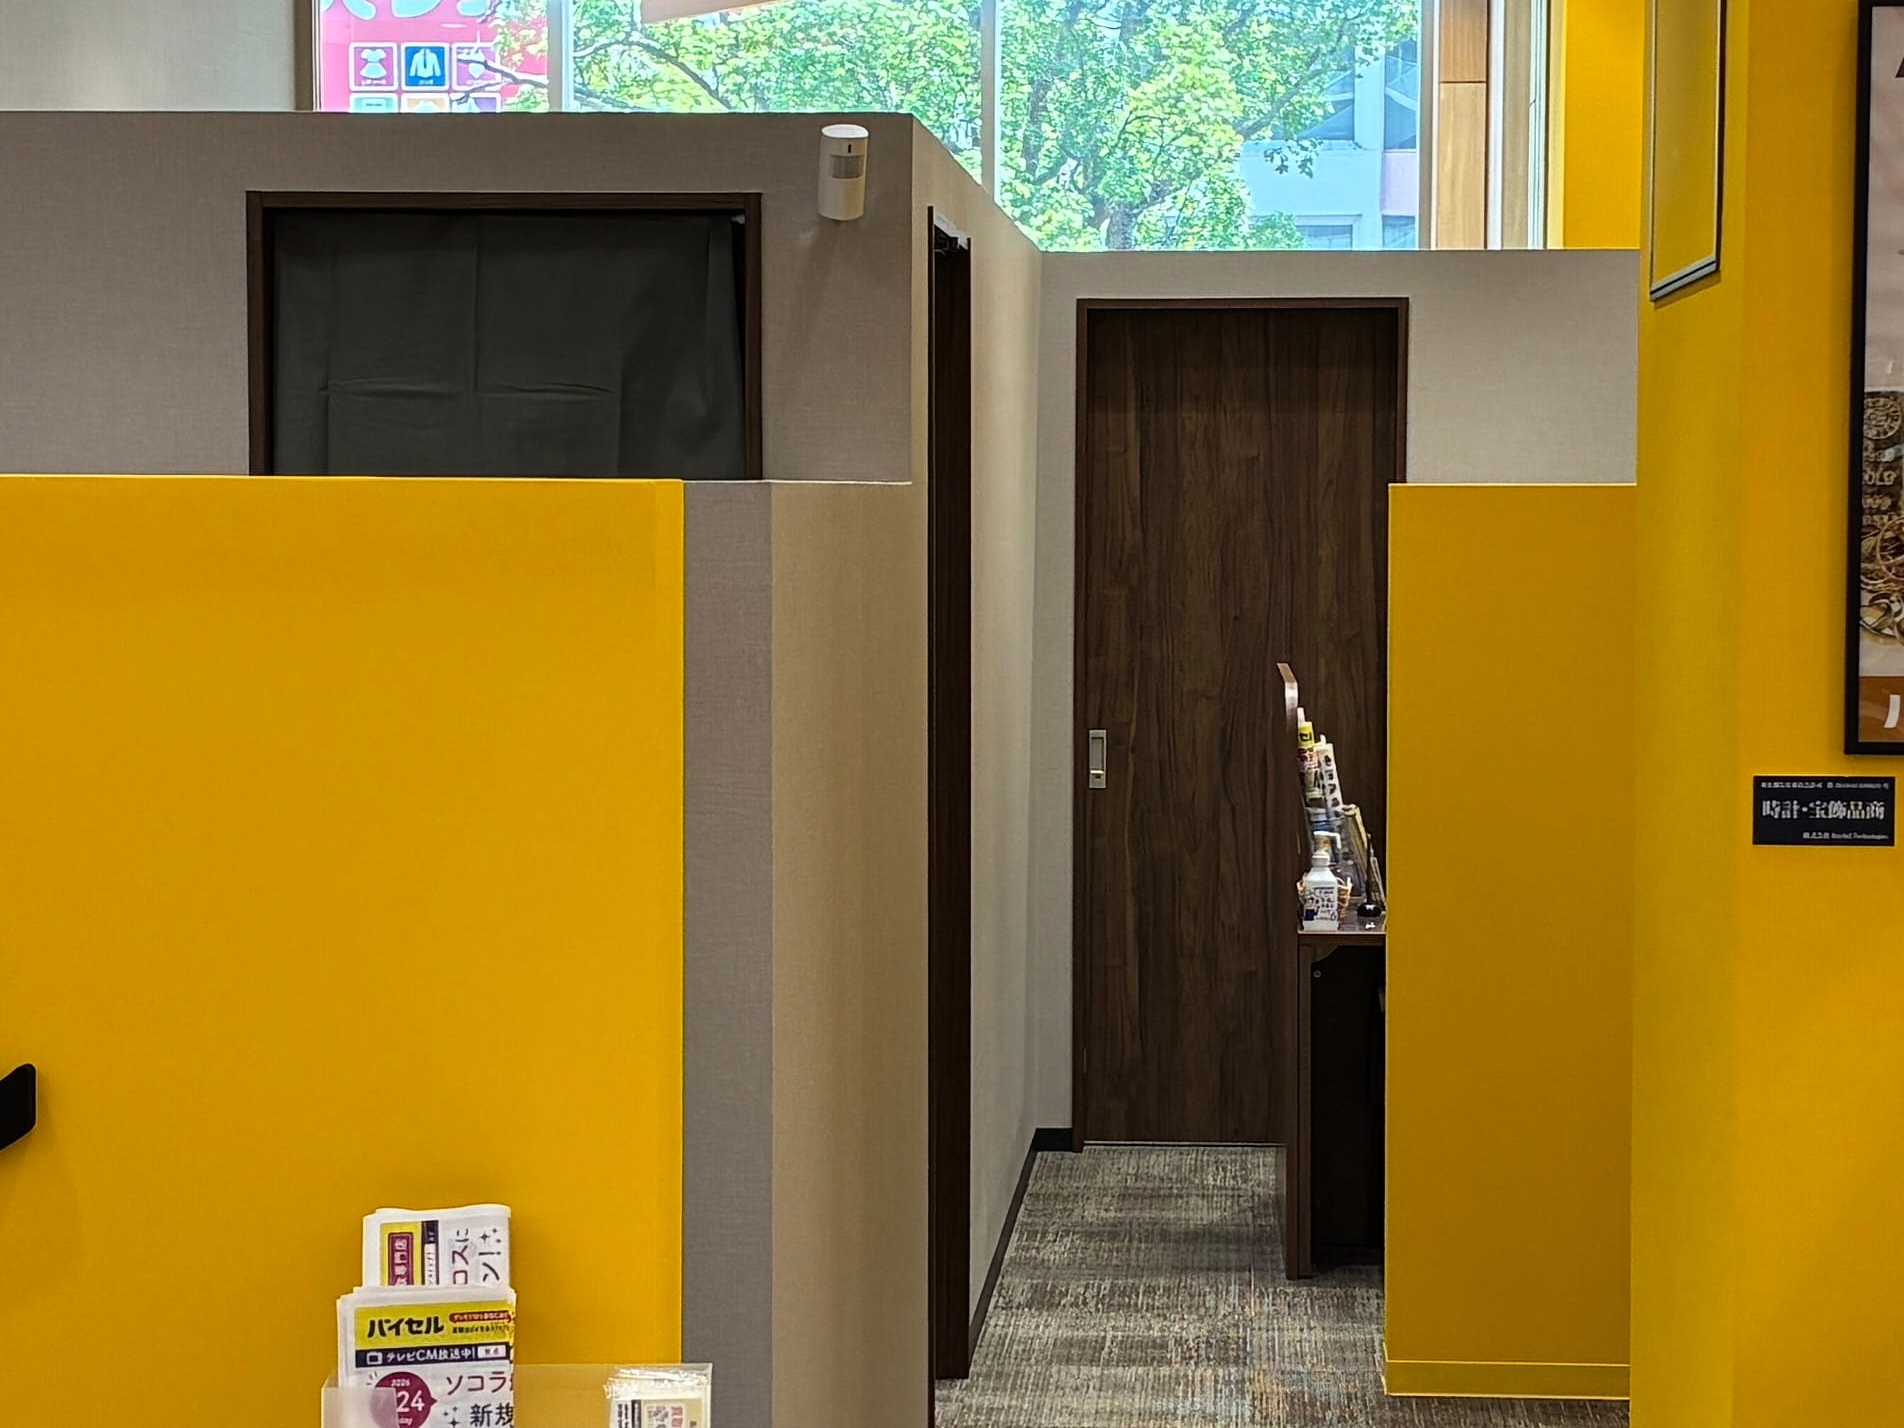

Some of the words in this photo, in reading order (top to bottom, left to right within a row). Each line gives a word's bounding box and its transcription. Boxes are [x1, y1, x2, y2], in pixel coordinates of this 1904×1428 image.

[367, 1316, 444, 1338] バイセル
[446, 1371, 513, 1396] ソコラ
